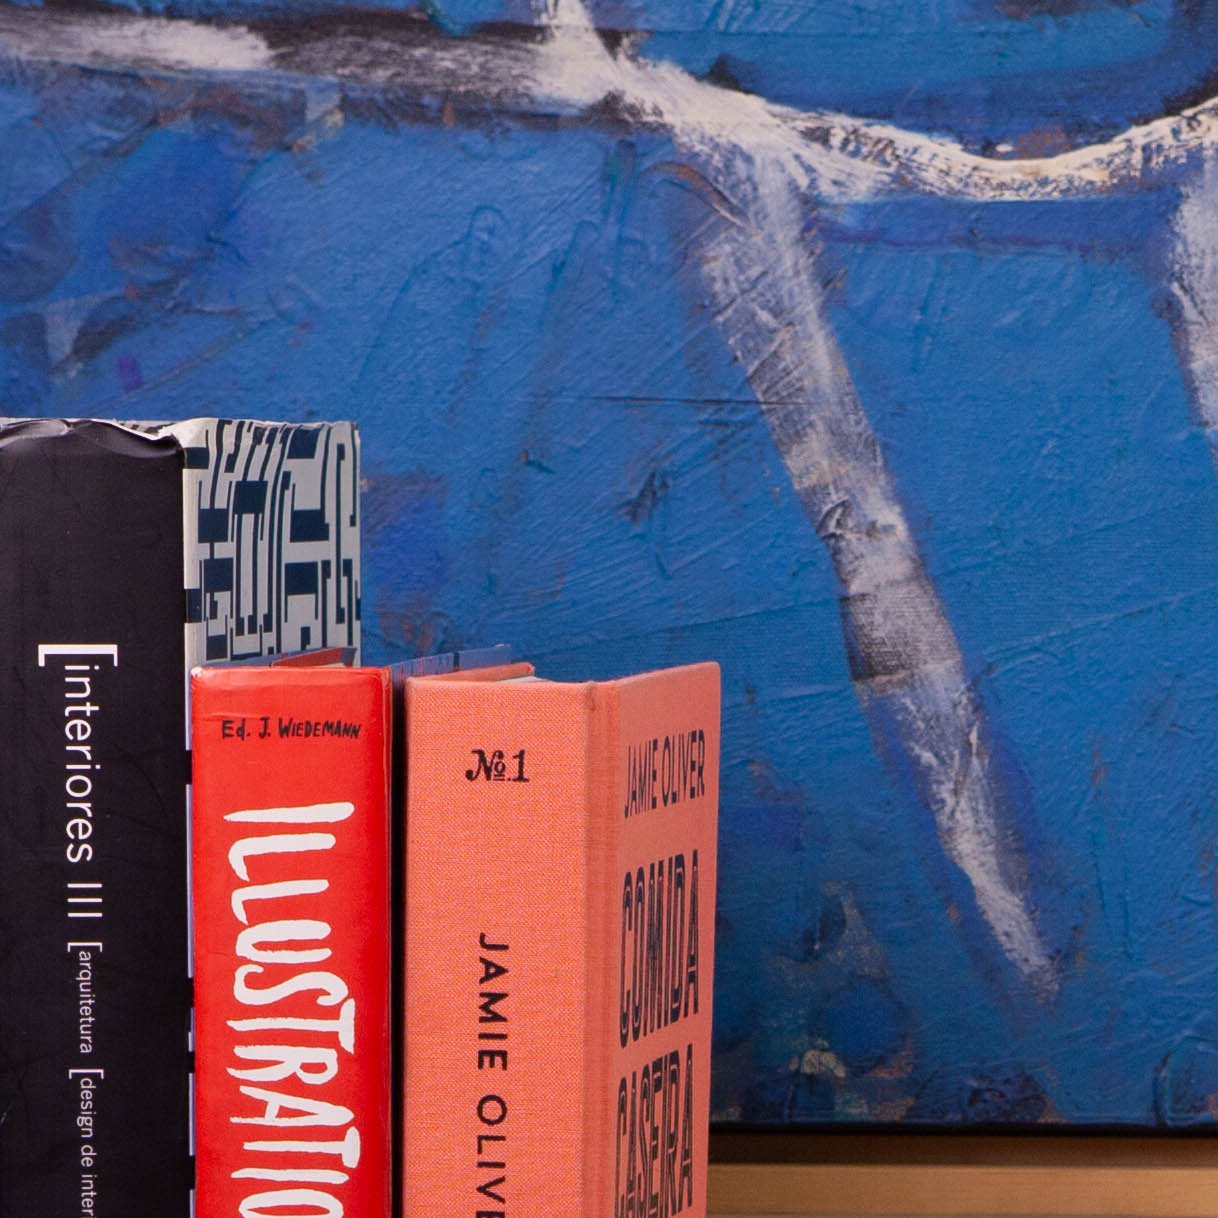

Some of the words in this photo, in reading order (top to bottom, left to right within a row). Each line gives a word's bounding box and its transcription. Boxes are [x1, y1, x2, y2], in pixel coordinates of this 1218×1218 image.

[221, 718, 251, 741] Ed.
[258, 716, 272, 739] J.
[624, 738, 658, 819] JAMIE
[661, 729, 706, 807] OLIVER
[67, 883, 103, 918] III
[619, 849, 699, 1049] COMIDA
[476, 932, 509, 1072] JAMIE
[80, 1144, 98, 1168] de
